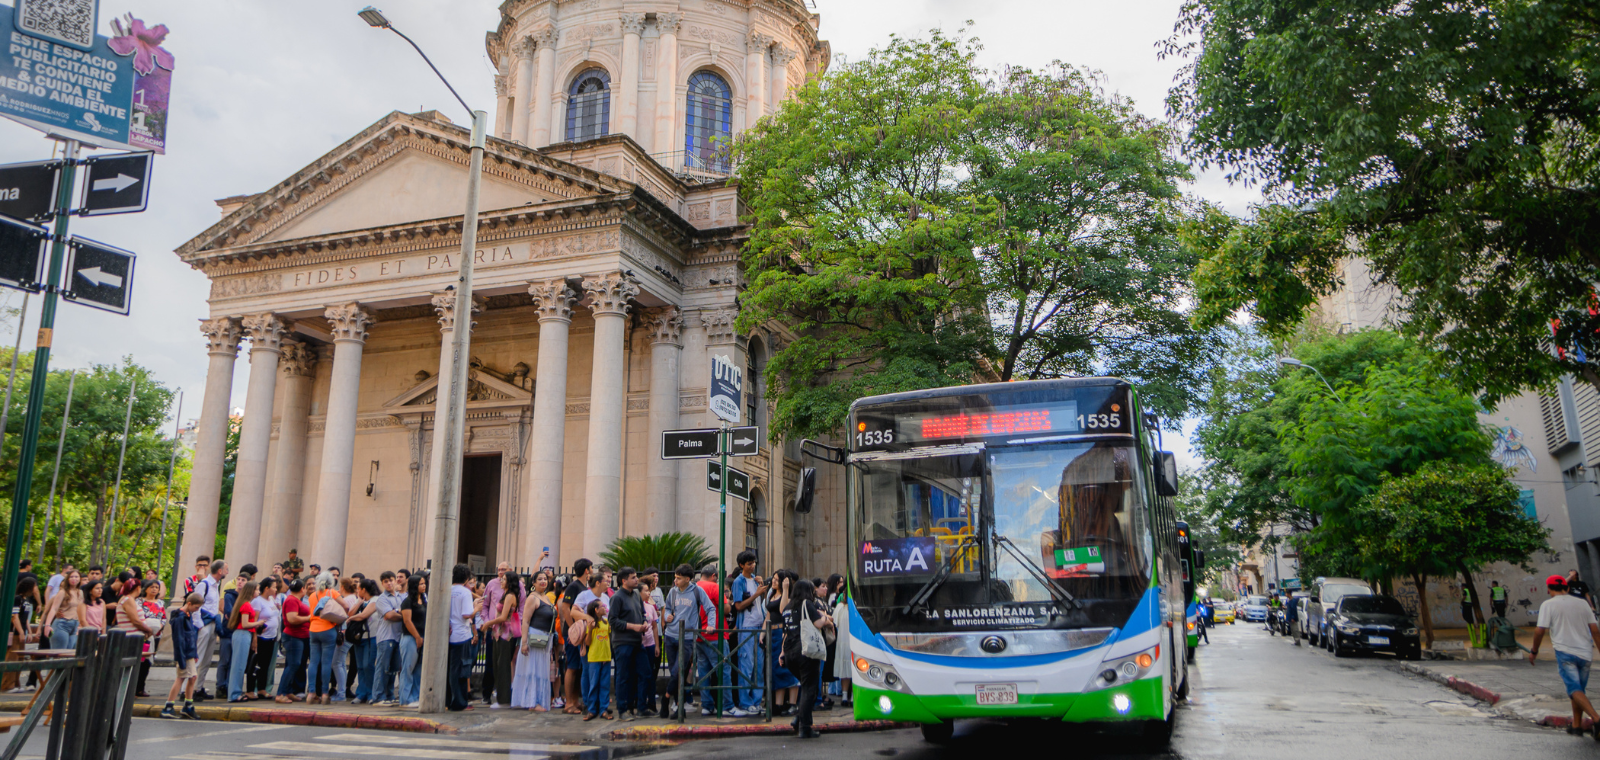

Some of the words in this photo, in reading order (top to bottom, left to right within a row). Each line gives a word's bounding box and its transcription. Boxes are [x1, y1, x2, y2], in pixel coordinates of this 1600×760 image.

[9, 43, 117, 83] PUBLICITARIO
[11, 31, 50, 53] ESTE
[53, 43, 118, 71] ESPACIO
[12, 56, 31, 70] TE
[35, 62, 112, 94] CONVIENE
[17, 70, 31, 83] &
[35, 74, 83, 97] CUIDA
[86, 90, 105, 103] EL
[49, 90, 127, 120] AMBIENTE
[131, 134, 164, 147] LAPACHO
[294, 266, 357, 287] FIDES
[380, 259, 406, 276] ET
[427, 246, 514, 270] PARIA
[714, 353, 742, 392] UTIC
[1077, 413, 1121, 429] 1535
[678, 439, 703, 448] Palma
[856, 429, 893, 447] 1535
[864, 558, 903, 574] RUTA
[905, 546, 929, 571] A
[944, 607, 1035, 618] SANLORENZANA
